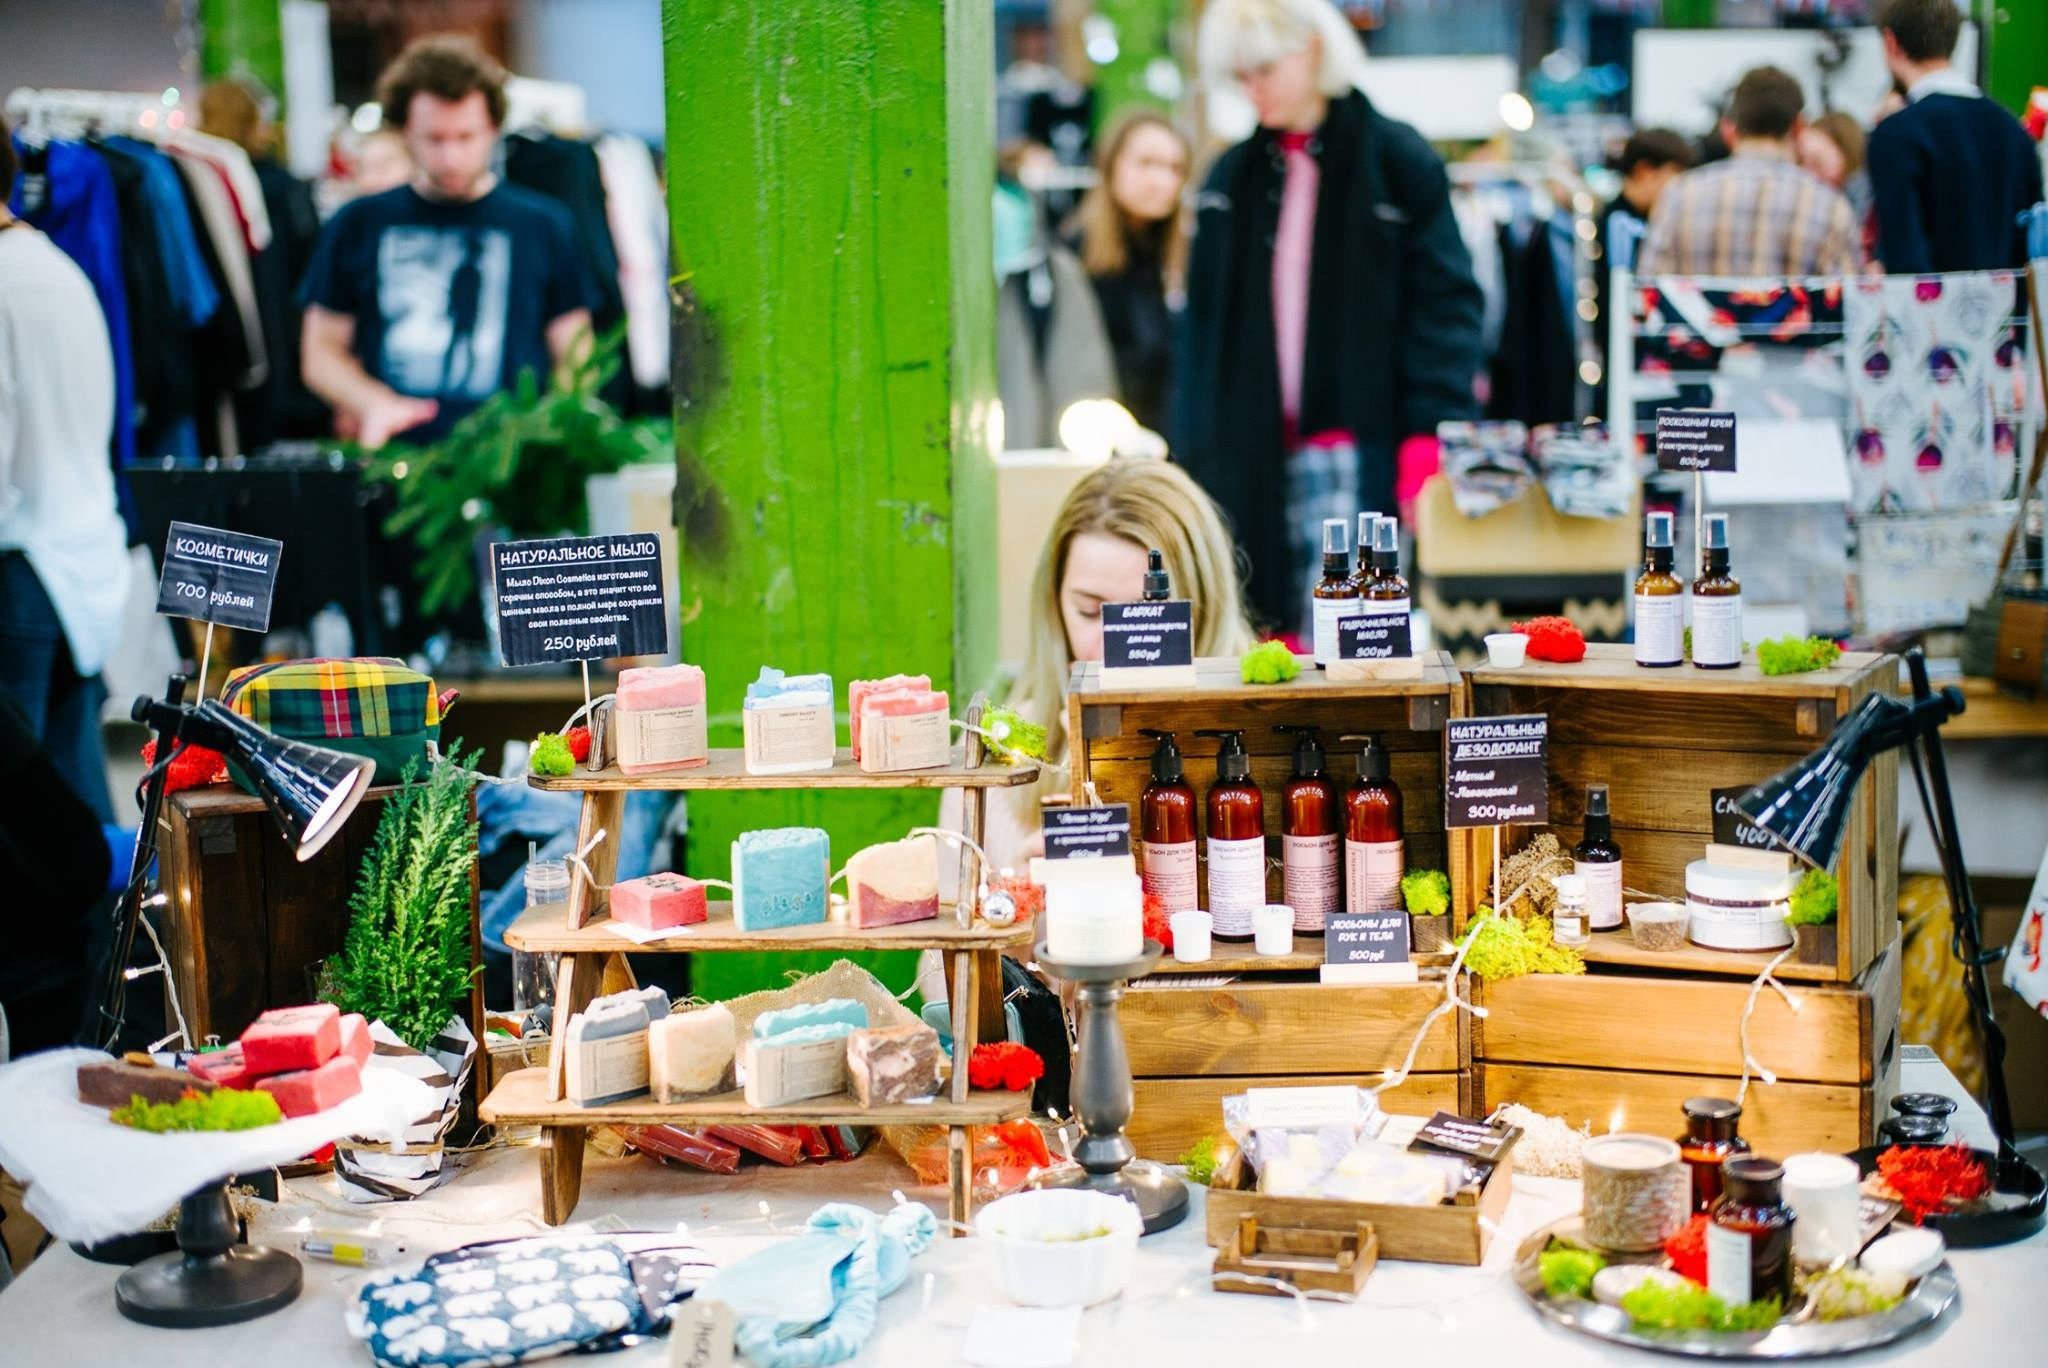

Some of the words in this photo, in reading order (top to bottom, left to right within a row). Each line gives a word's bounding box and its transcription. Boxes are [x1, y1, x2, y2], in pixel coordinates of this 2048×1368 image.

[1659, 416, 1709, 427] РОСКОШНЫЙ
[1710, 418, 1733, 428] КРЕМ
[176, 537, 269, 567] КОСМЕТИЧКИ
[500, 545, 606, 565] НАТУРАЛЬНОЕ
[611, 541, 656, 557] МЫЛО
[506, 577, 532, 587] Мыло
[533, 575, 555, 585] Dixon
[557, 573, 596, 584] Cosmetics
[597, 571, 649, 581] изготовлено
[176, 582, 206, 599] 700
[210, 591, 254, 608] рублей
[500, 594, 534, 604] горячим
[535, 589, 576, 600] способом,
[599, 586, 626, 595] значит
[501, 608, 531, 617] ценные
[533, 606, 559, 614] масла
[567, 602, 596, 611] полной
[598, 601, 617, 610] мере
[618, 597, 662, 609] сохранили
[1122, 605, 1165, 618] БАРХАТ
[528, 620, 547, 629] свои
[549, 618, 588, 627] полезные
[590, 614, 630, 625] свойства.
[1340, 616, 1407, 630] ГИДРОФИЛЬНОЕ
[1357, 629, 1389, 640] МАСЛО
[544, 637, 574, 651] 250
[576, 634, 618, 652] рублей
[1451, 721, 1547, 739] НАТУРАЛЬНЫЙ
[1455, 741, 1541, 758] ДЕЗОДОРАНТ
[1468, 805, 1496, 818] 300
[1497, 804, 1535, 820] рублей
[1331, 919, 1379, 930] ЛОСЬОНЫ
[1379, 918, 1402, 930] ДЛЯ
[1338, 932, 1359, 942] РУК
[1359, 932, 1367, 941] И
[1368, 931, 1394, 941] ТЕЛА
